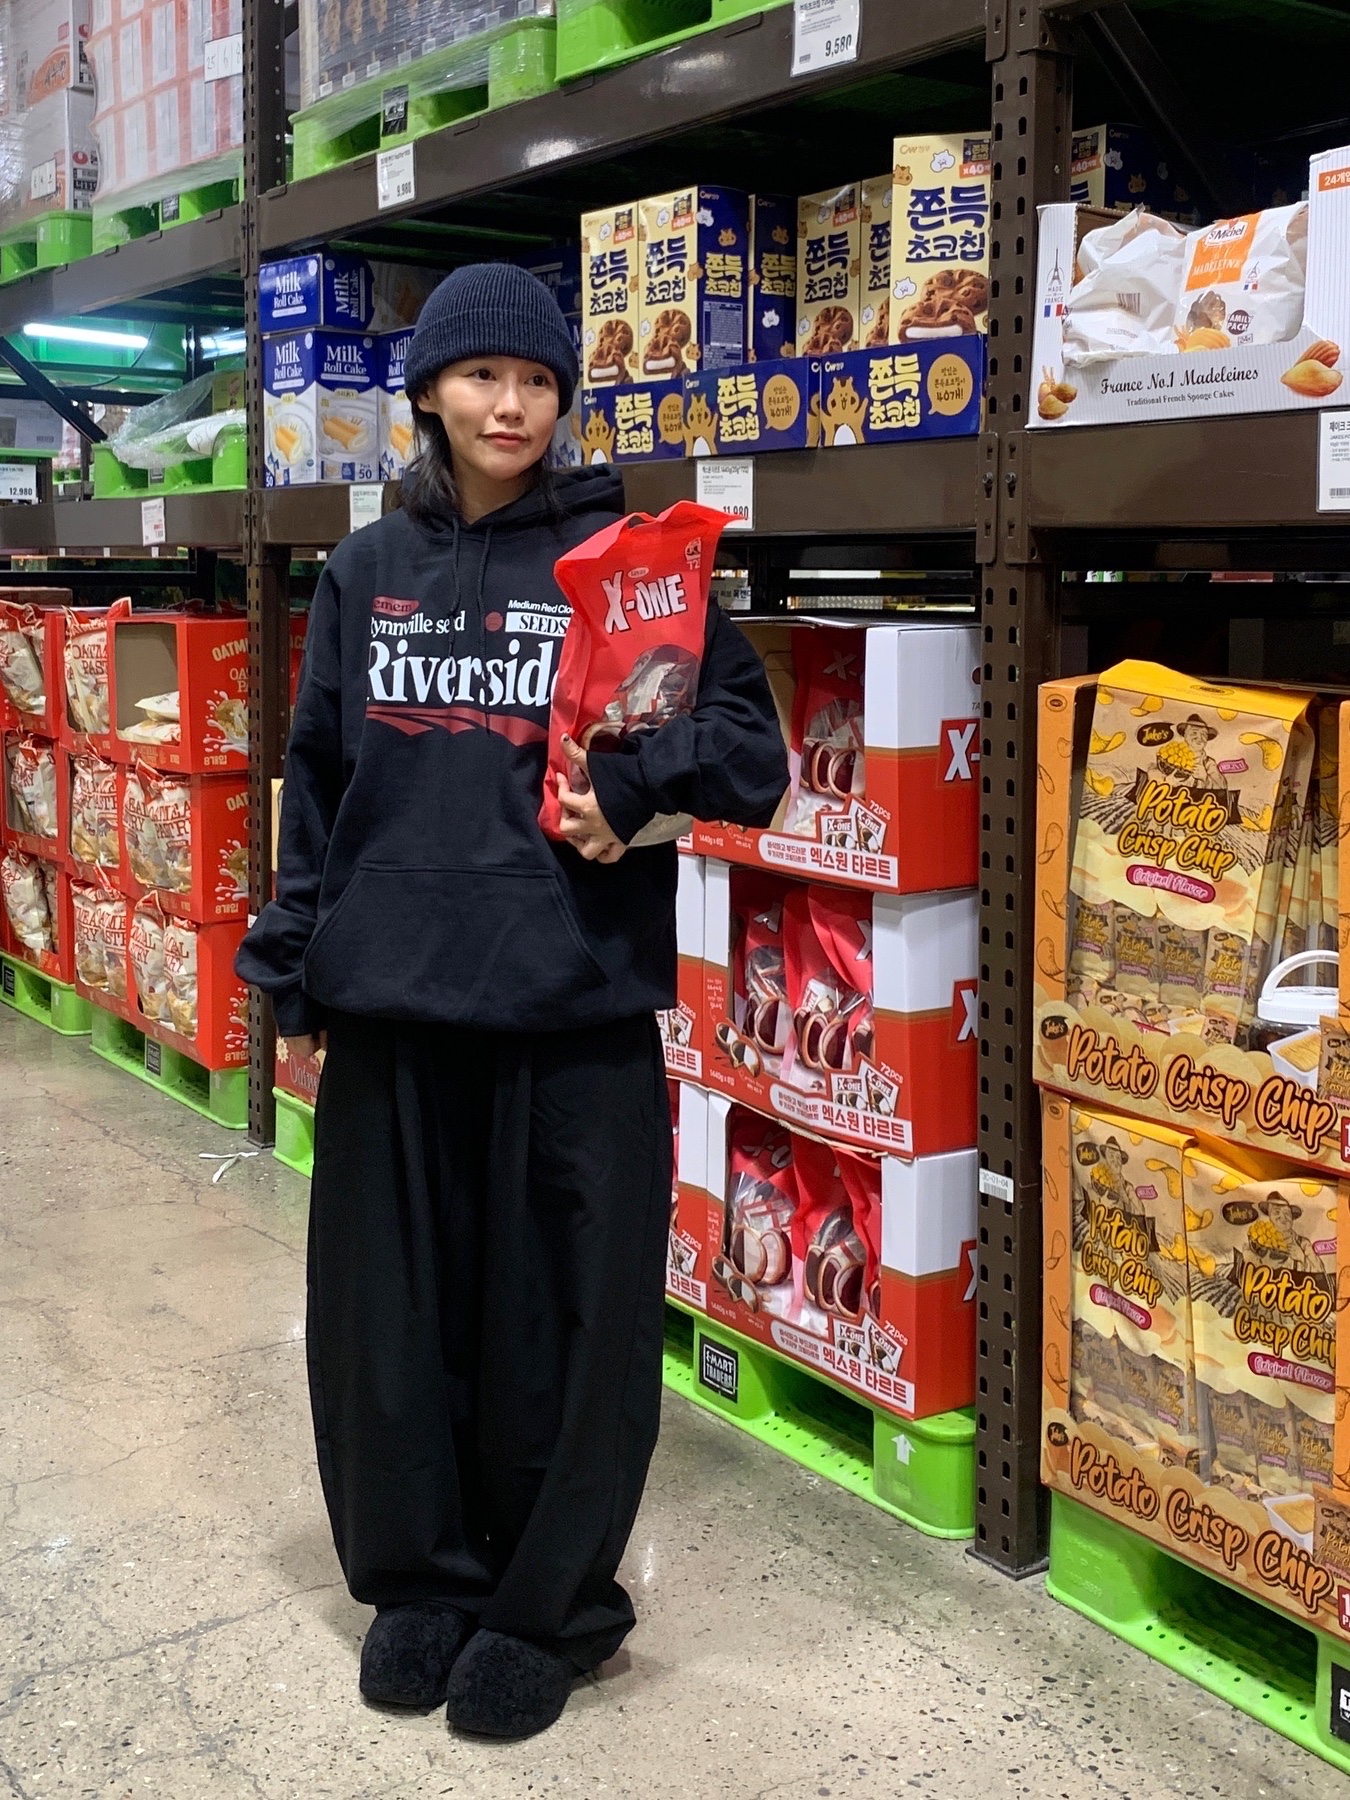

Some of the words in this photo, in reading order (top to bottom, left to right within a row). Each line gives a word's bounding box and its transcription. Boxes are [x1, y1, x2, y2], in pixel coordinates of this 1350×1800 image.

[825, 34, 852, 57] 9,580
[907, 183, 989, 232] 쫀득
[868, 220, 891, 263] 쫀
[905, 230, 986, 264] 초코칩
[1215, 225, 1245, 240] Michel
[645, 235, 687, 279] 쫀득
[705, 252, 743, 280] 쫀득
[760, 252, 797, 280] 쫀득
[804, 231, 850, 276] 쫀득
[275, 271, 301, 295] Milk
[350, 269, 358, 296] Cake
[589, 248, 629, 291] 쫀득
[274, 296, 288, 308] Roll
[288, 294, 304, 305] Cake
[334, 271, 350, 314] Milk
[589, 287, 628, 316] 초코칩
[645, 276, 687, 306] 초코칩
[704, 278, 742, 298] 초코칩
[760, 278, 796, 298] 초코칩
[804, 272, 848, 304] 초코칩
[350, 297, 359, 318] Roll
[1227, 322, 1249, 330] PACK
[275, 340, 300, 365] Milk
[326, 345, 364, 364] Milk
[389, 336, 411, 362] Mil
[274, 366, 287, 380] Roll
[287, 365, 303, 378] Cake
[323, 362, 342, 374] Roll
[344, 364, 367, 375] Cake
[868, 353, 922, 398] 쫀득
[1101, 378, 1143, 394] France
[1147, 371, 1174, 389] No.1
[1180, 366, 1259, 387] Madeleines
[717, 373, 759, 418] 쫀득
[1126, 396, 1162, 407] Traditional
[1163, 393, 1186, 403] French
[1187, 391, 1212, 403] Sponge
[1213, 389, 1235, 398] Cakes
[614, 391, 654, 430] 쫀득
[868, 395, 921, 430] 초코칩
[616, 426, 654, 455] 초코칩
[718, 413, 760, 443] 초코칩
[358, 469, 372, 480] 50
[9, 487, 33, 496] 12,980
[723, 505, 749, 520] 11980
[508, 599, 541, 611] Medium
[541, 602, 558, 613] Red
[600, 570, 687, 635] X-ONE
[519, 614, 568, 635] SEEDS
[367, 639, 559, 707] Riversid
[1142, 727, 1170, 744] Jake's
[828, 819, 851, 831] X-ONE
[856, 808, 881, 834] X-ONE
[869, 799, 892, 821] 72pcs
[1137, 781, 1228, 835] Potato
[810, 847, 848, 873] 엑스원
[852, 854, 891, 880] 타르트
[1118, 822, 1178, 869] Crisp
[1176, 834, 1237, 882] Chip
[1133, 868, 1172, 888] Original
[1174, 876, 1208, 898] Flavor
[665, 1045, 697, 1071] 타르트
[880, 1061, 904, 1084] 72pcs
[838, 1078, 862, 1091] X-ONE
[866, 1069, 892, 1096] X-ONE
[1067, 1025, 1158, 1097] Potato
[1165, 1055, 1248, 1130] Crisp
[1255, 1076, 1337, 1153] Chip
[821, 1104, 859, 1132] 엑스원
[863, 1115, 905, 1144] 타르트
[681, 1229, 702, 1250] 72pcs
[1089, 1200, 1149, 1258] Potato
[670, 1273, 702, 1302] 타르트
[1082, 1241, 1119, 1285] Crisp
[1119, 1259, 1162, 1308] Chip
[1242, 1263, 1332, 1323] Potato
[840, 1324, 865, 1344] X-ONE
[870, 1324, 896, 1356] X-ONE
[884, 1320, 909, 1346] 72pcs
[1234, 1306, 1292, 1358] Crisp
[706, 1363, 733, 1388] TRADERS
[823, 1346, 862, 1383] 엑스원
[865, 1367, 907, 1404] 타르트
[1254, 1356, 1292, 1375] Original
[1292, 1365, 1331, 1388] Flavor
[1070, 1437, 1159, 1521] Potato
[1166, 1488, 1248, 1571] Crisp
[1254, 1530, 1334, 1614] Chip
